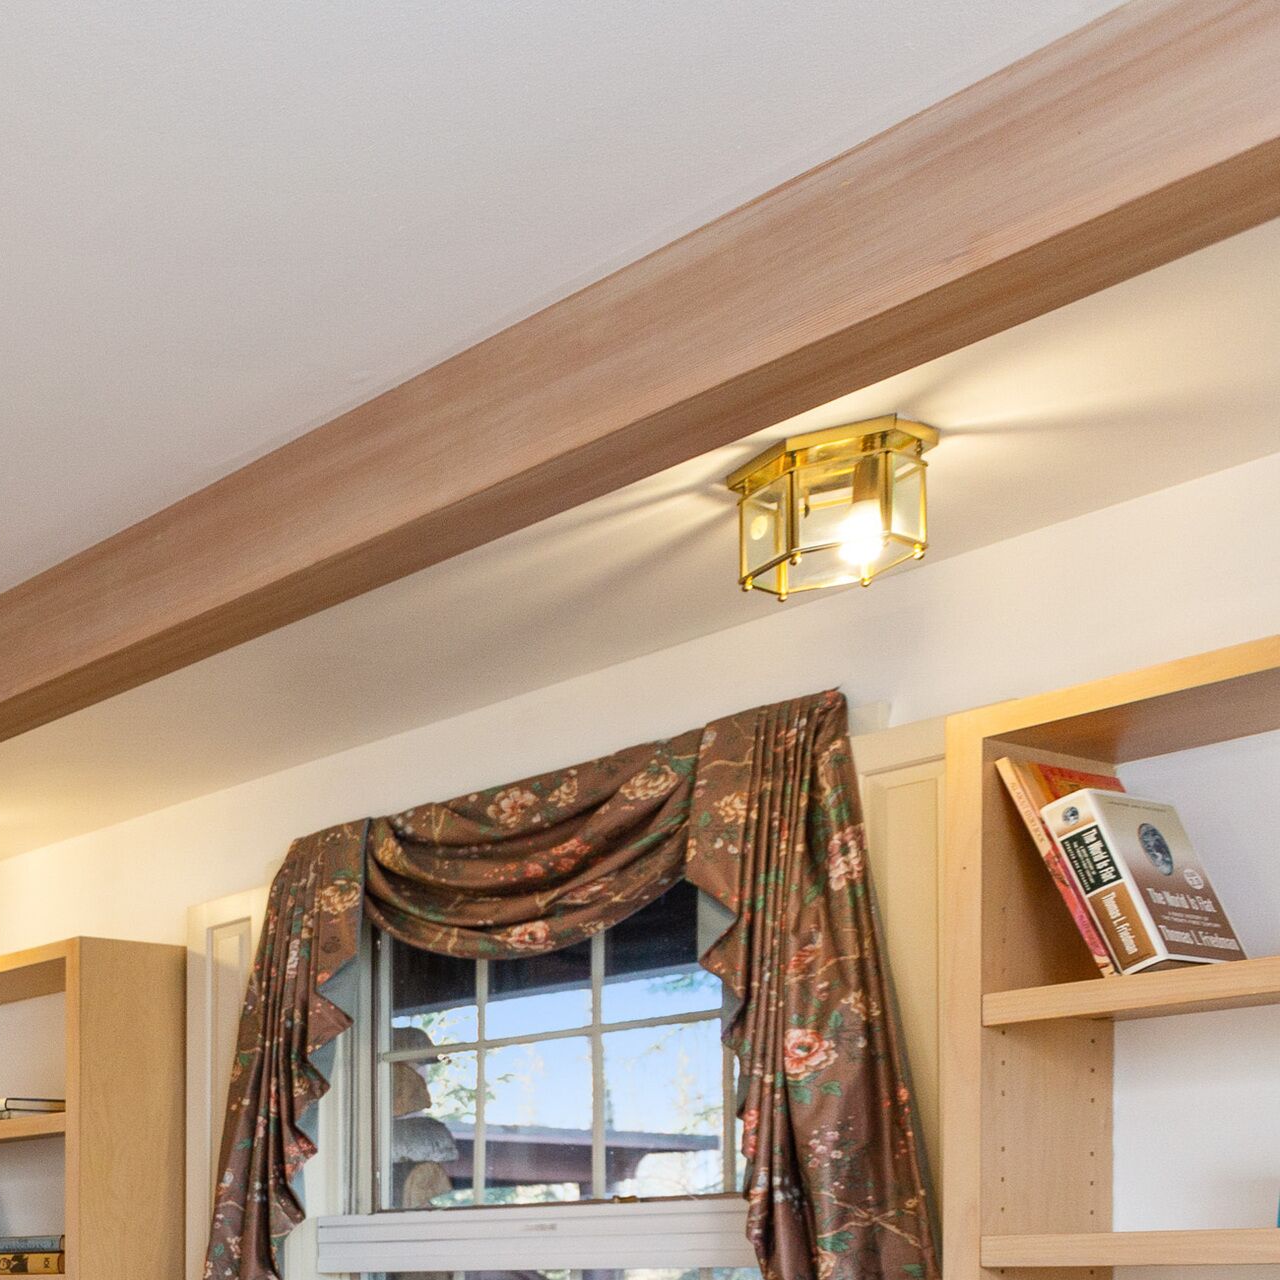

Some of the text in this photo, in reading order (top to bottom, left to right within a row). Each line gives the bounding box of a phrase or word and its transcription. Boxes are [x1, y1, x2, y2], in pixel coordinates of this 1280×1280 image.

[1082, 828, 1098, 844] The
[1086, 840, 1107, 864] World
[1099, 867, 1115, 884] Flat
[1101, 891, 1139, 956] Thomas L. Friedman
